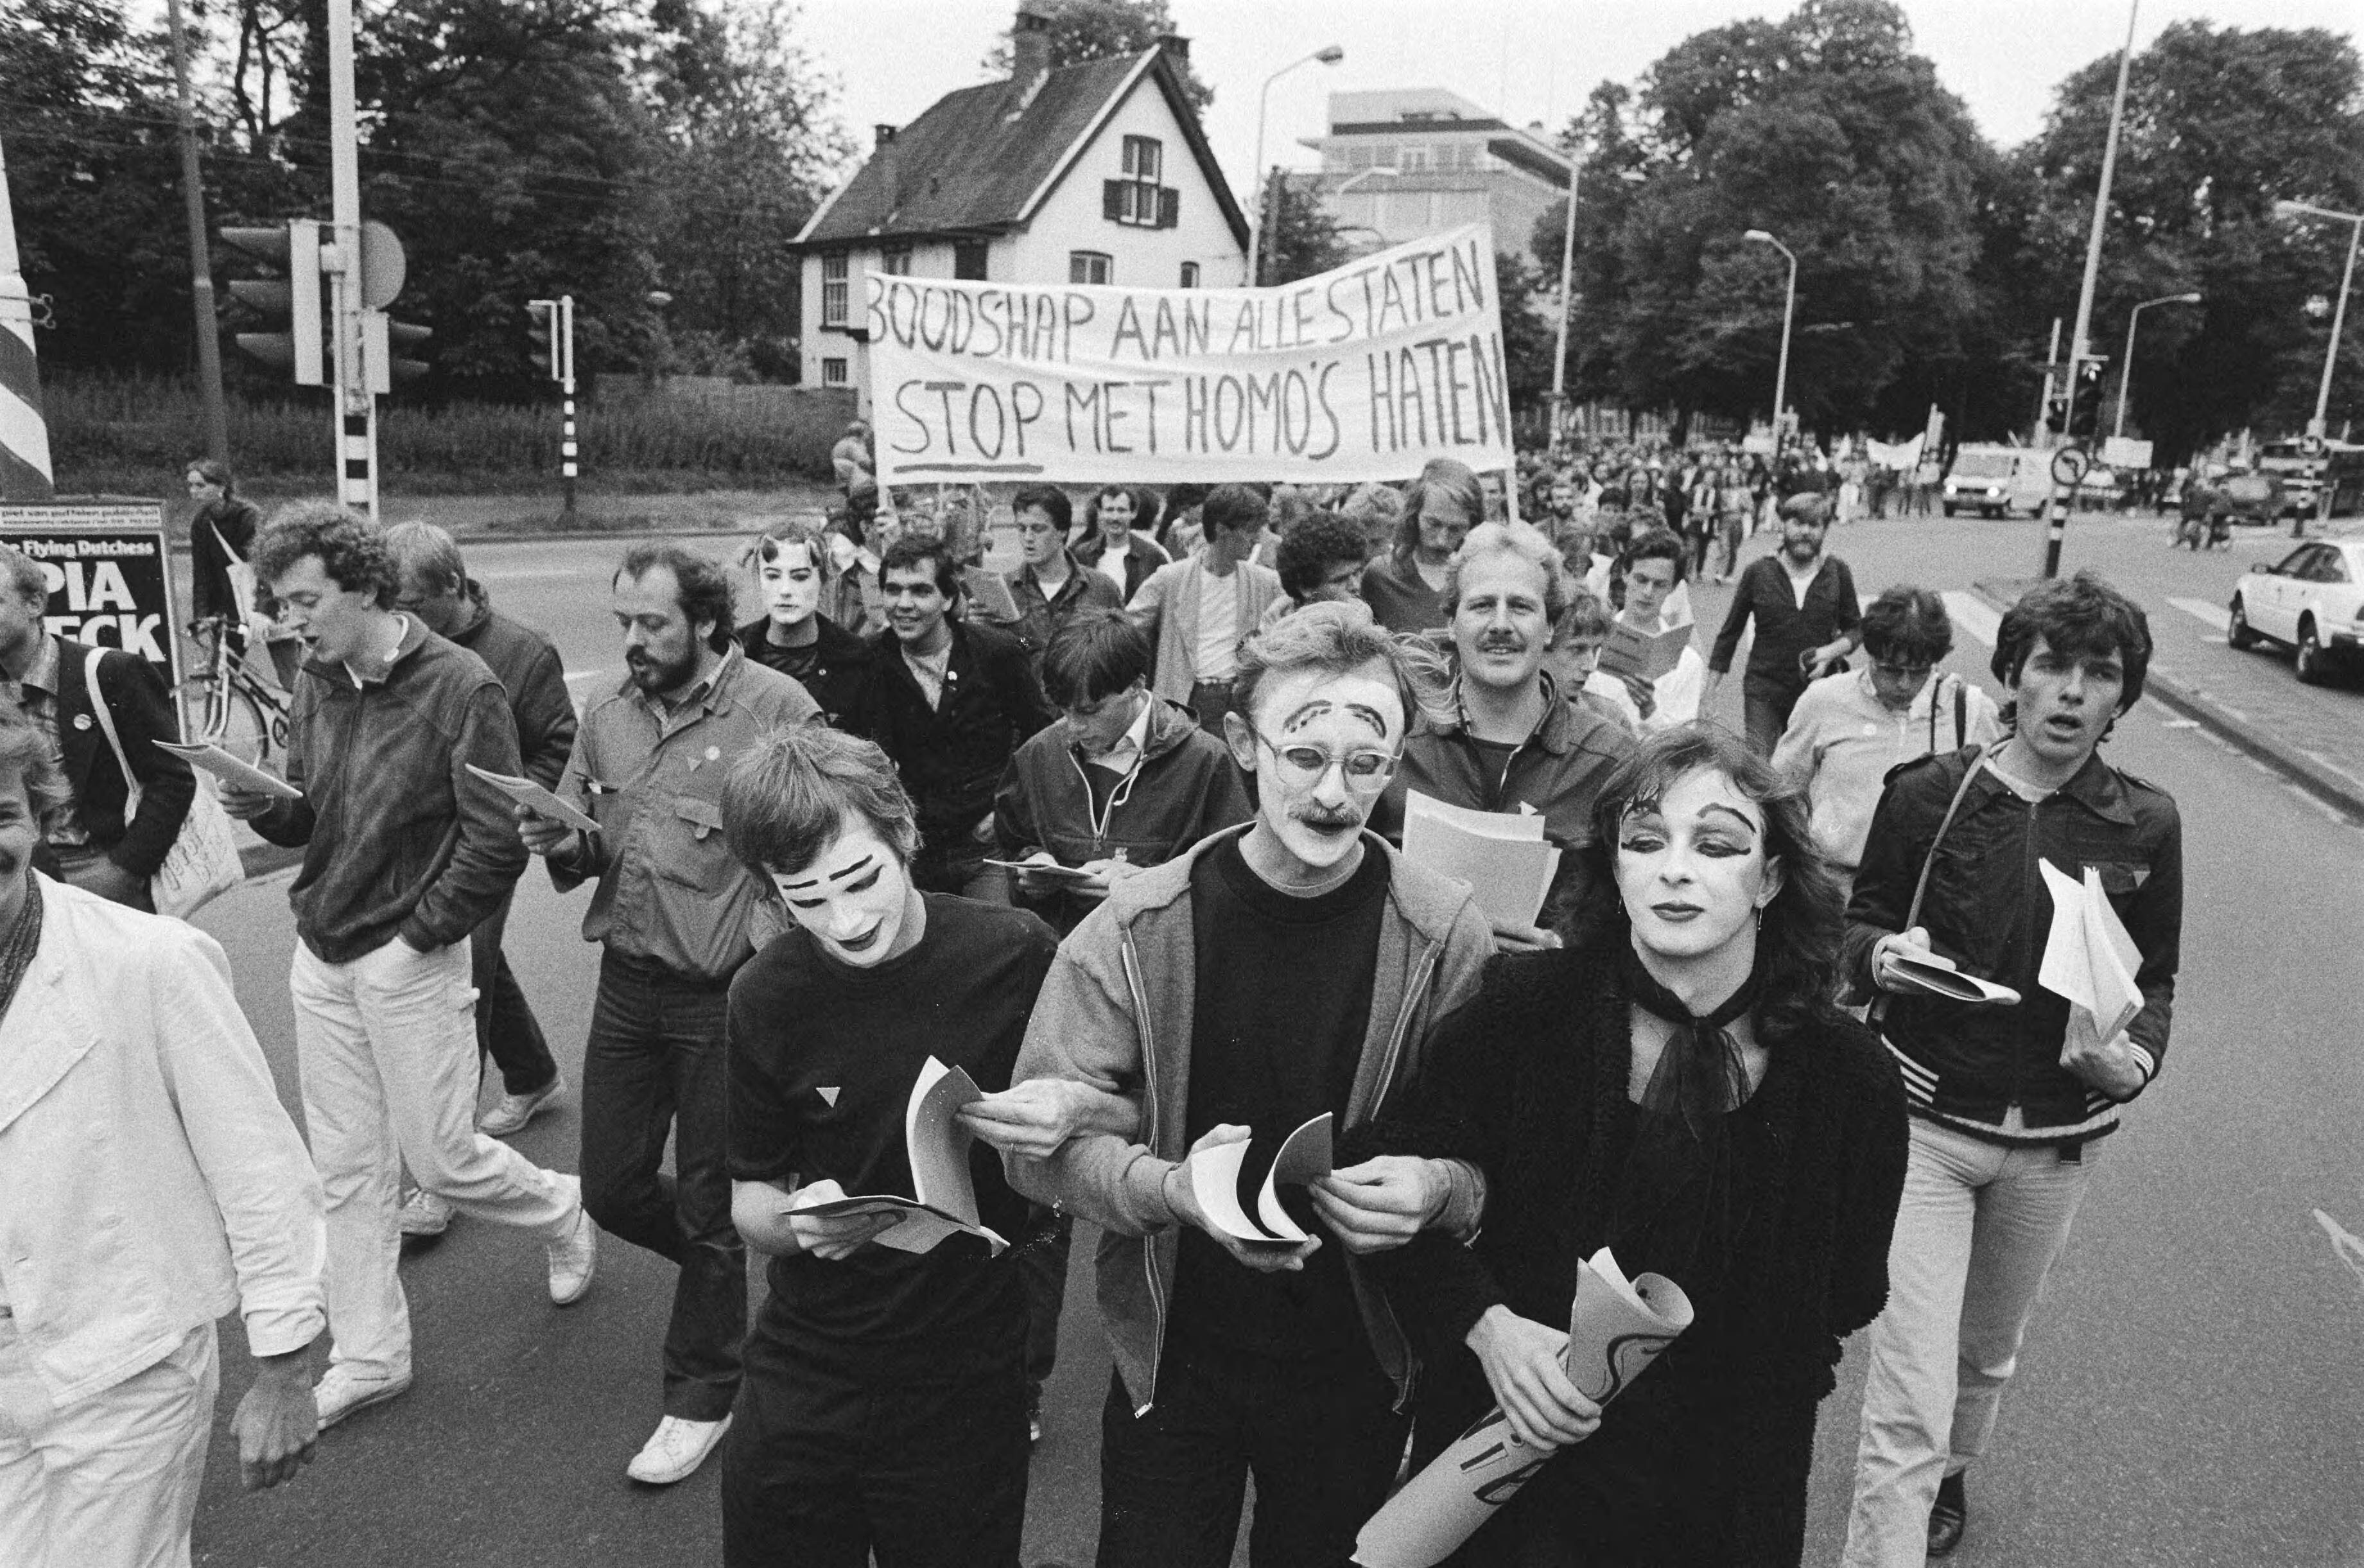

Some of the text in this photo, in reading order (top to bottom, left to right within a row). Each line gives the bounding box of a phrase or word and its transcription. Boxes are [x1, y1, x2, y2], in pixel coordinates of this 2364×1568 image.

[1111, 295, 1210, 361] AAN
[1228, 287, 1316, 356] ALLE
[1327, 240, 1484, 343] STATEN
[891, 333, 1507, 460] STOP MET HOMO'S HATEN
[22, 539, 76, 559] Flying
[42, 613, 166, 662] ECK
